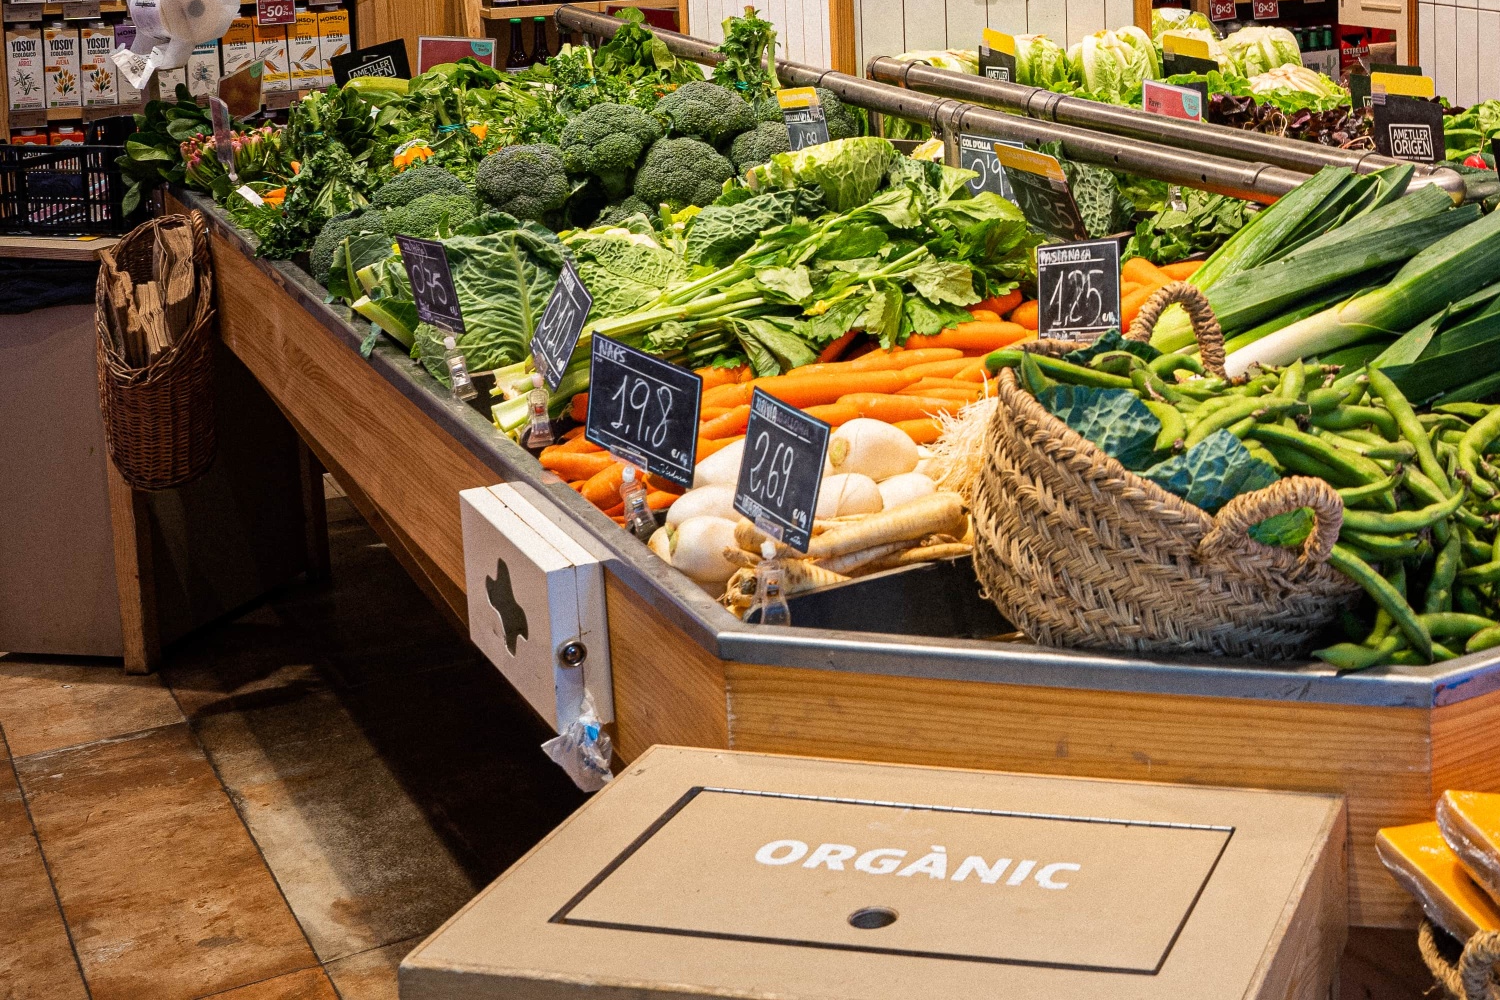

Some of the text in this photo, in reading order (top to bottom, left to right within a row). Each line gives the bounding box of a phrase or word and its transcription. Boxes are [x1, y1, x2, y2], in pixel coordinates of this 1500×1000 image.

[352, 59, 391, 77] AMETLLER
[961, 138, 972, 147] COL
[1392, 128, 1429, 142] AMETLLER
[1394, 139, 1431, 156] ORIGEN
[598, 339, 627, 364] NAPS
[754, 838, 1081, 890] ORGÀNIC
